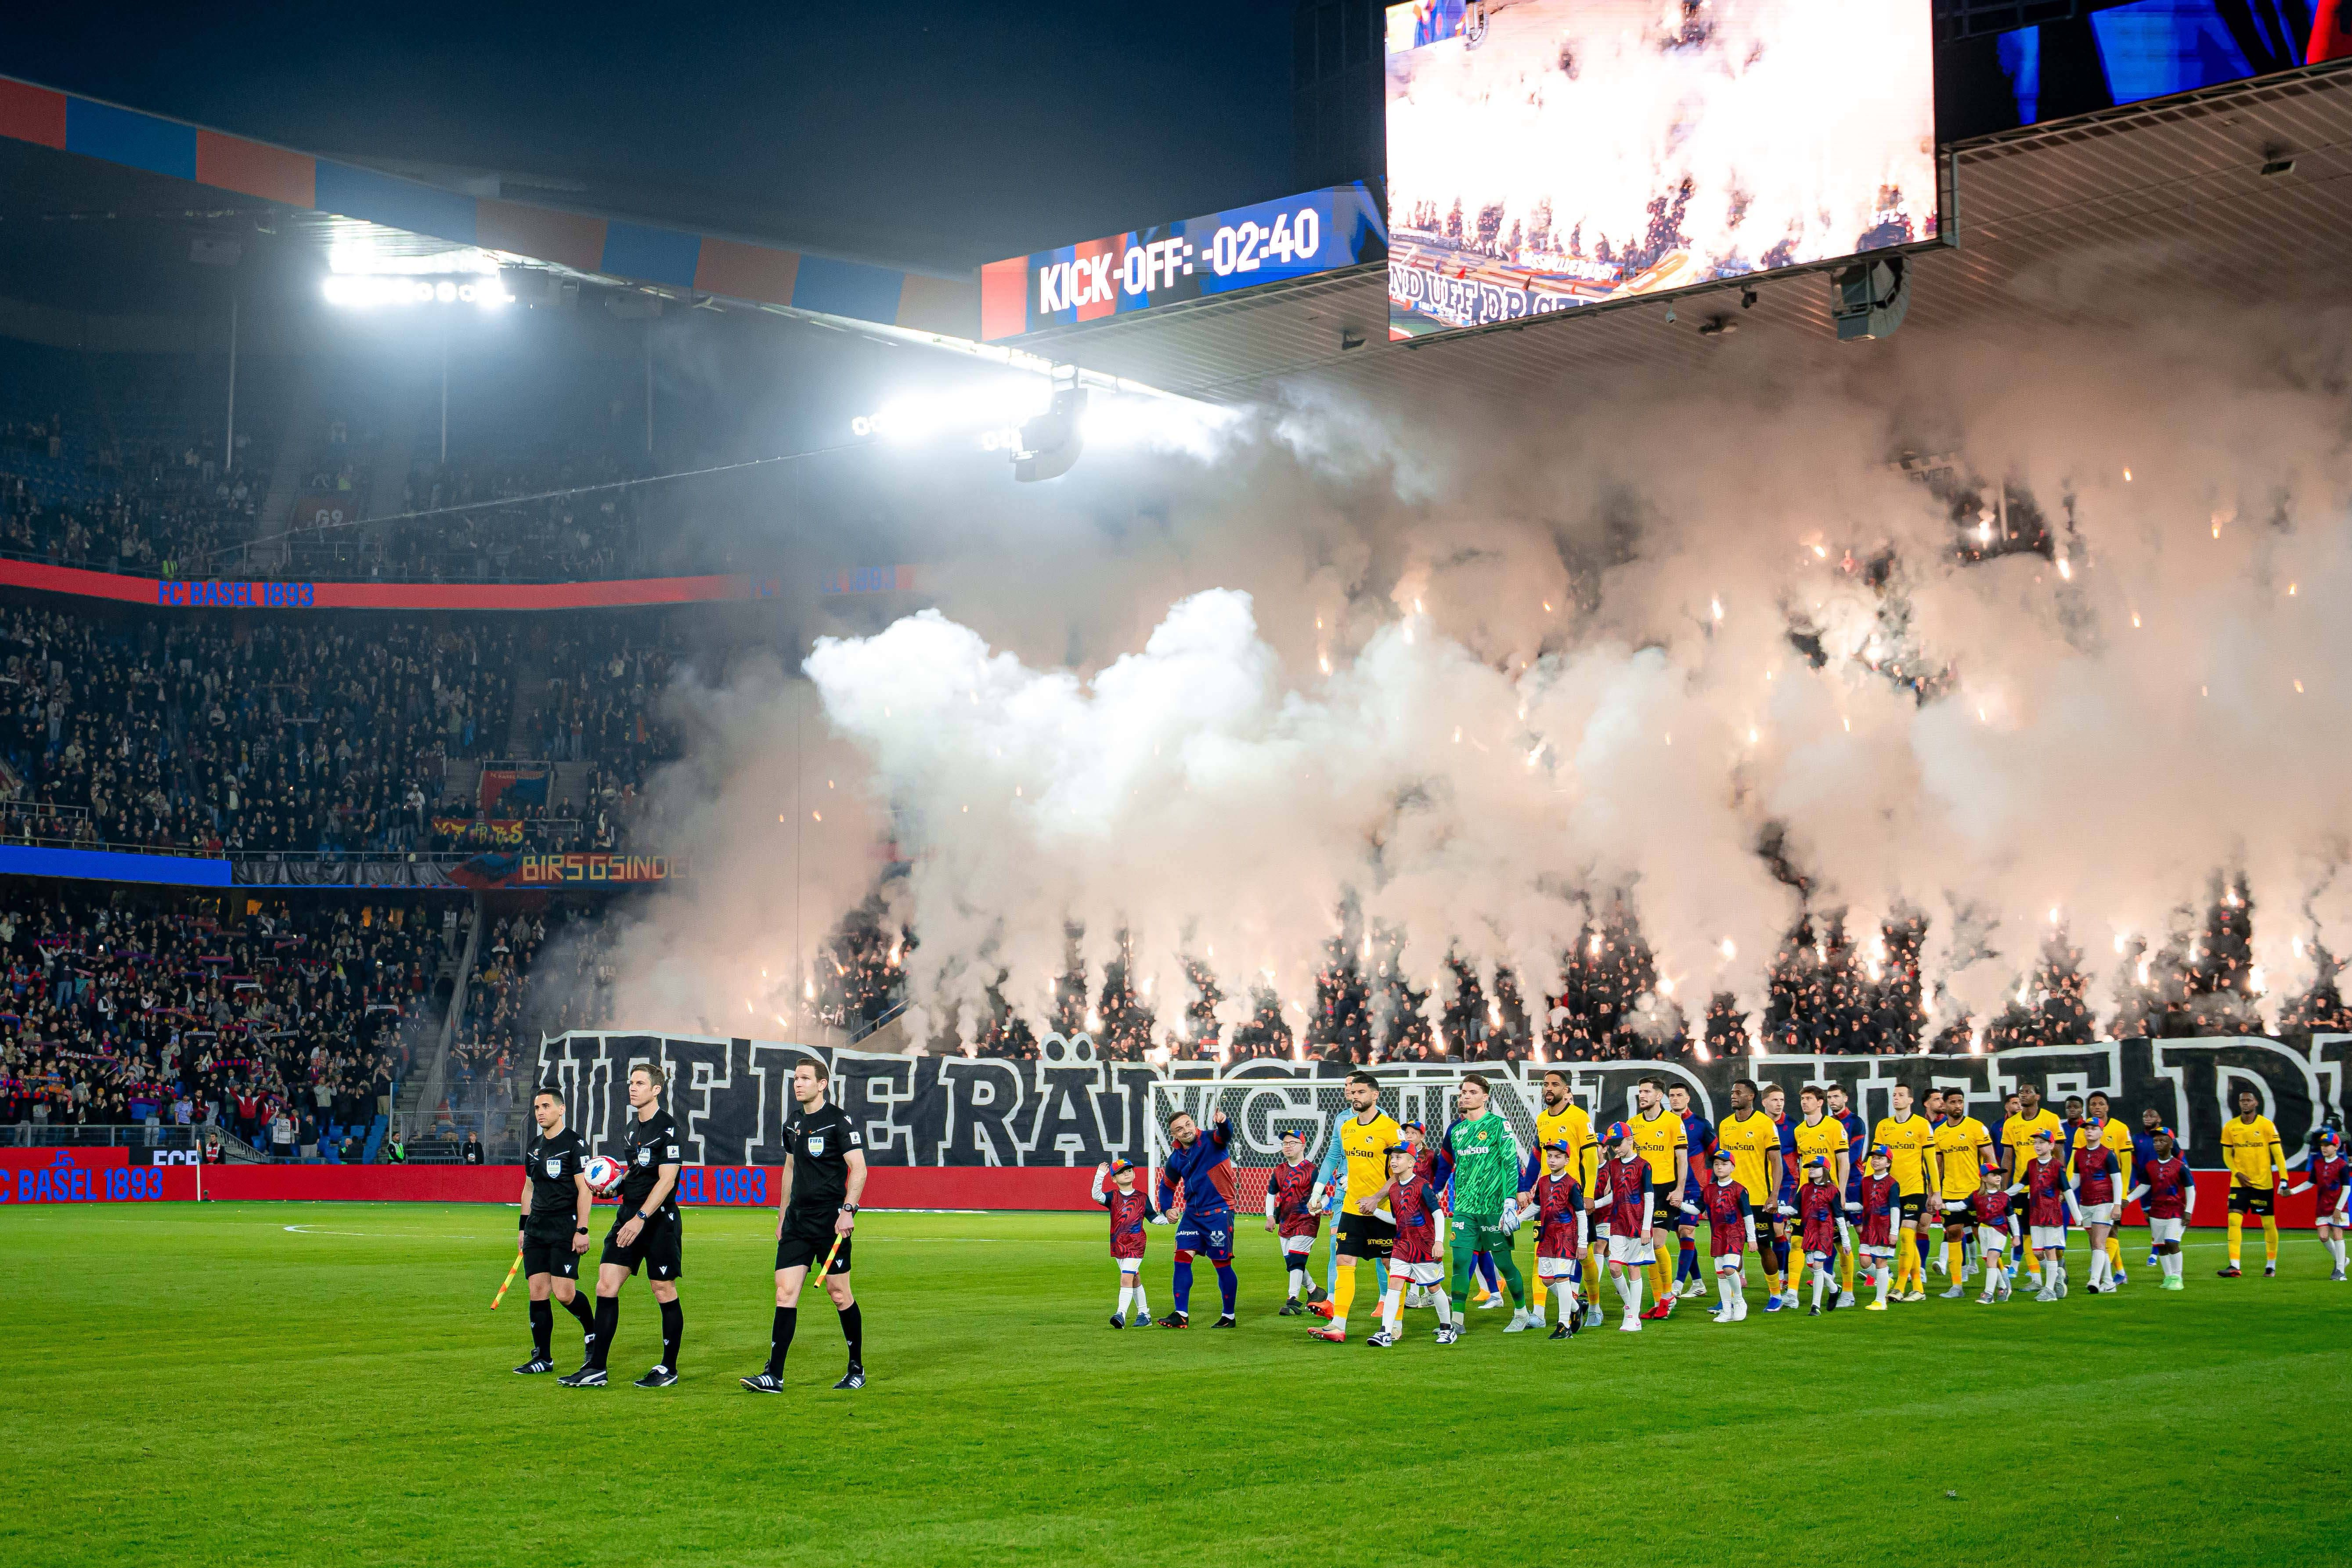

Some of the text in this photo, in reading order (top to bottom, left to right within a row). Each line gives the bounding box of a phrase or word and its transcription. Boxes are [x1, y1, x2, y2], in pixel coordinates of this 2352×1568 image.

[1040, 208, 1319, 314] KICK-OFF: -02:40
[159, 581, 314, 606] FC BASEL 1893
[18, 1169, 97, 1202] BASEL
[105, 1168, 163, 1200] 1893
[675, 1169, 767, 1204] SEL 1893
